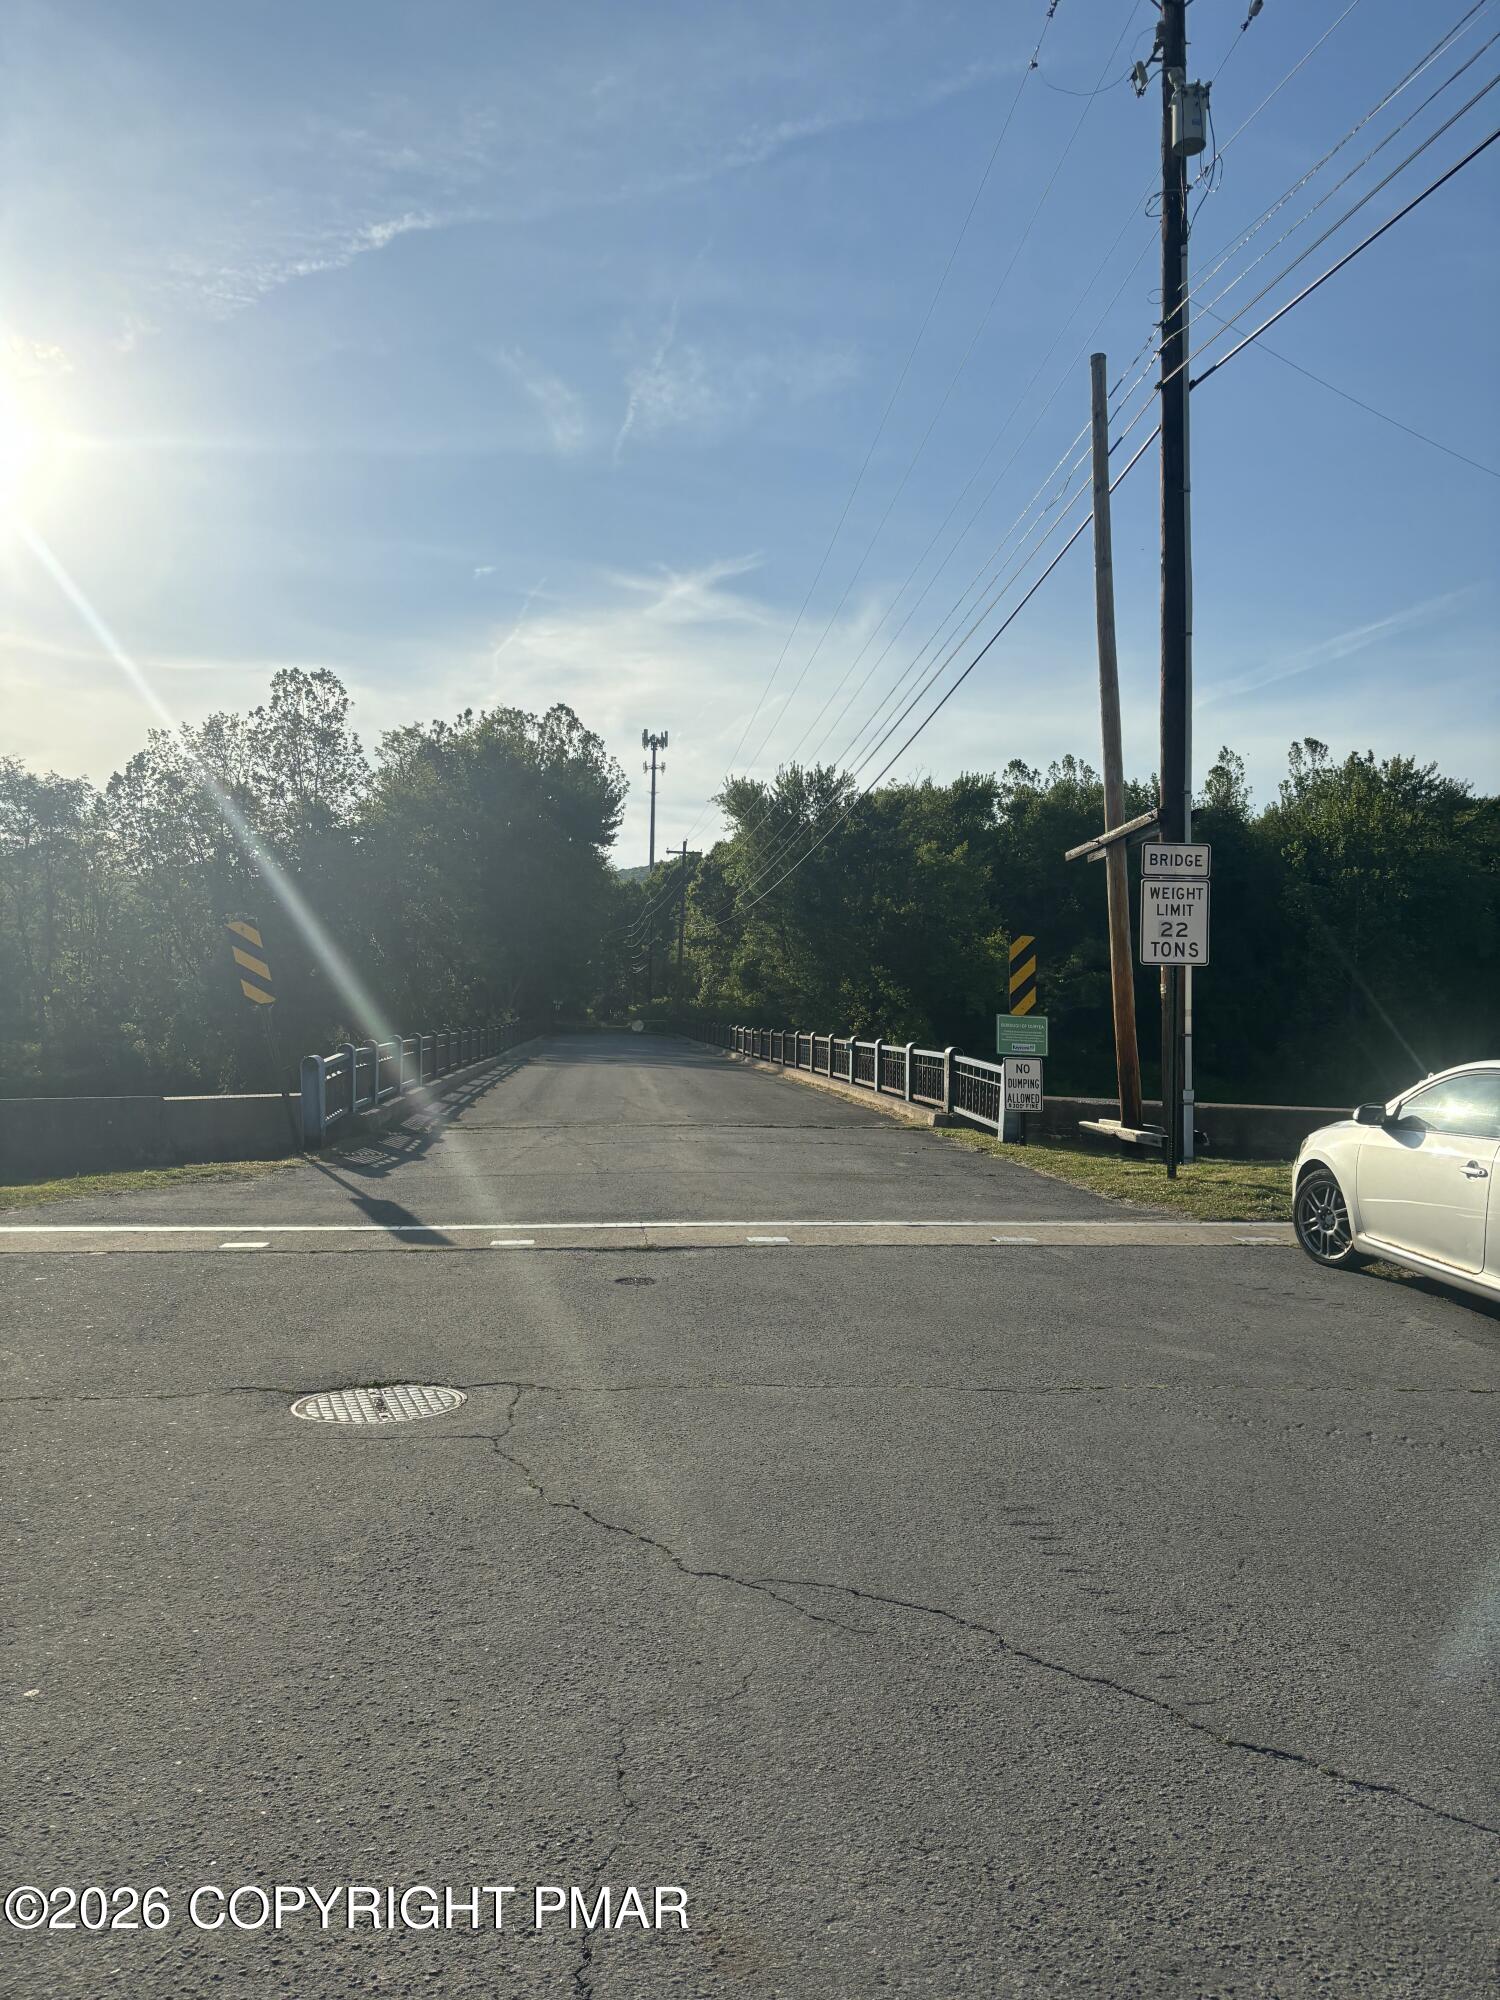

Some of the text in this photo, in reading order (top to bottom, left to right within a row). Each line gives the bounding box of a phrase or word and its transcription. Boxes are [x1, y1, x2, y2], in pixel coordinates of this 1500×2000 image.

[1149, 853, 1204, 867] BRIDGE
[1150, 886, 1204, 900] WEIGHT
[1156, 903, 1194, 917] LIMIT
[1160, 921, 1189, 938] 22
[1150, 941, 1199, 958] TONS
[1015, 1063, 1031, 1074] NO
[1007, 1078, 1040, 1089] DUMPING
[1007, 1092, 1040, 1104] ALLOWED
